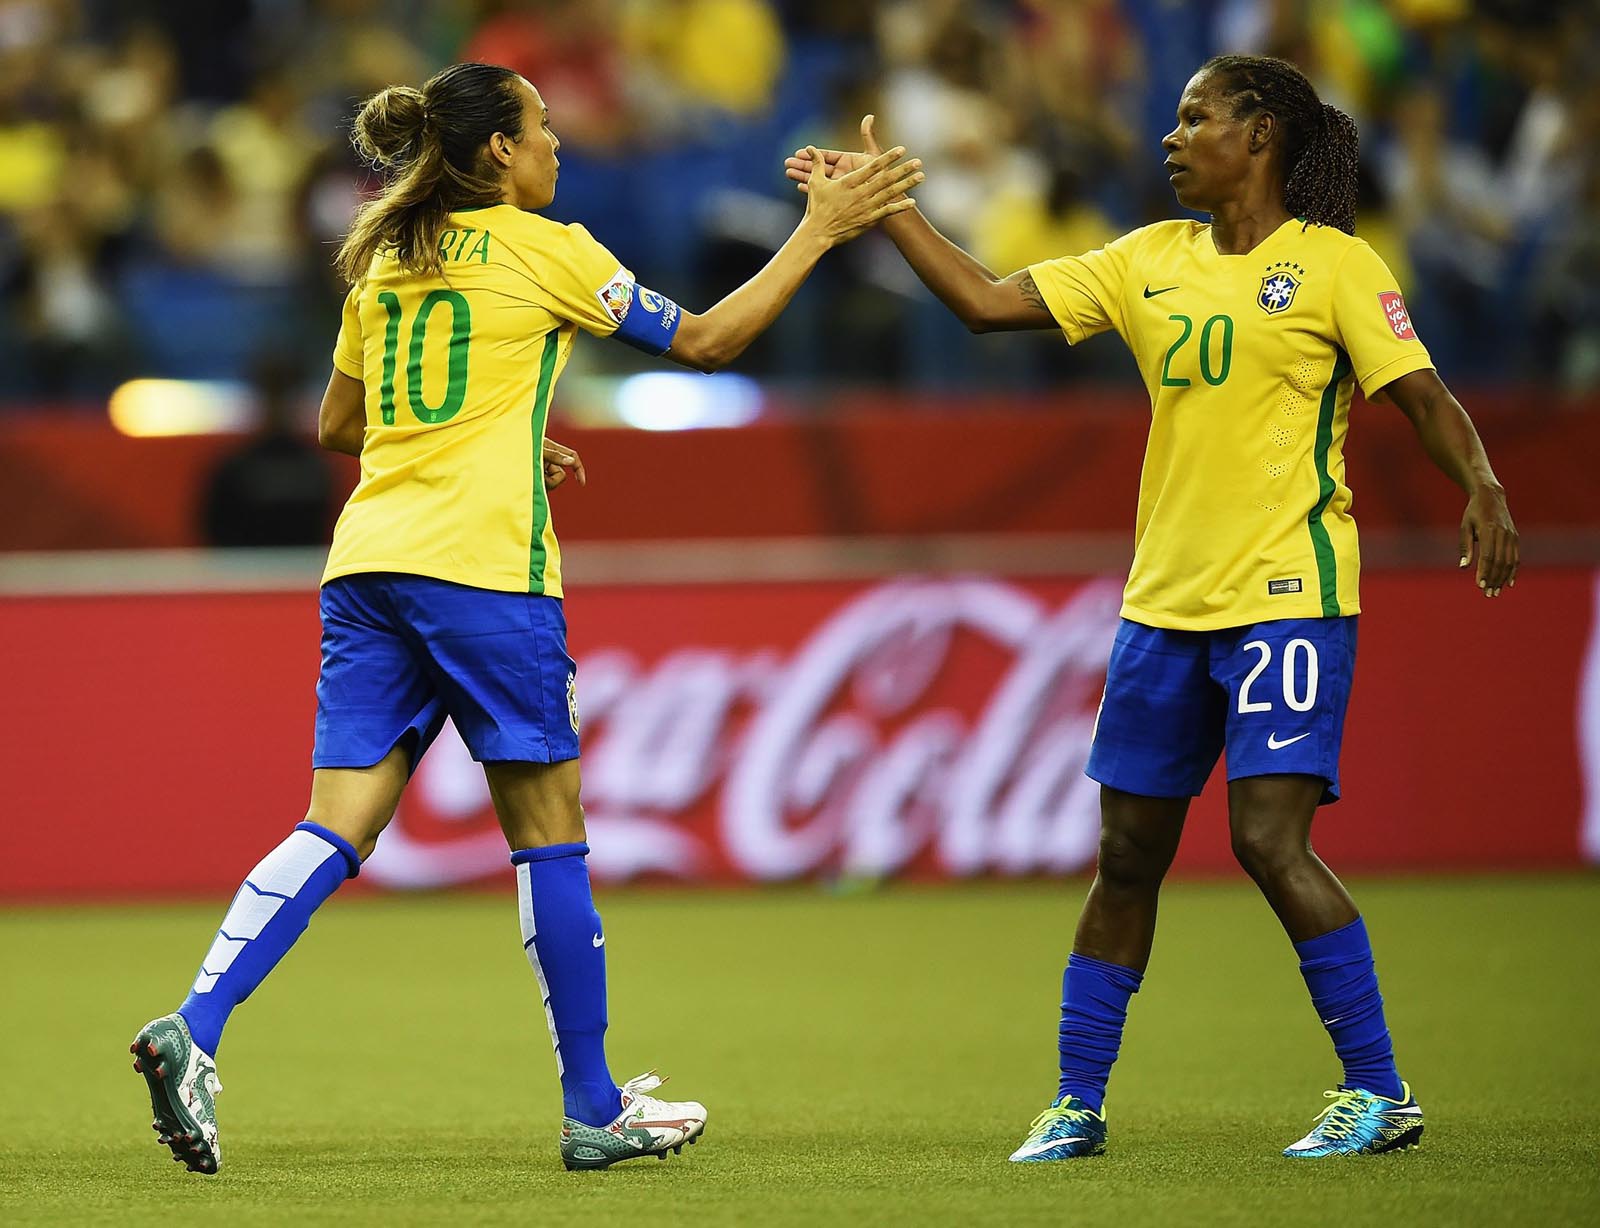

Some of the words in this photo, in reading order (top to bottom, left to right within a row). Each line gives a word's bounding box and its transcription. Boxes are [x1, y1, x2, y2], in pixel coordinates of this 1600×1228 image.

[438, 229, 490, 264] RTA
[378, 289, 472, 425] 10
[1162, 314, 1234, 387] 20
[1238, 638, 1319, 714] 20
